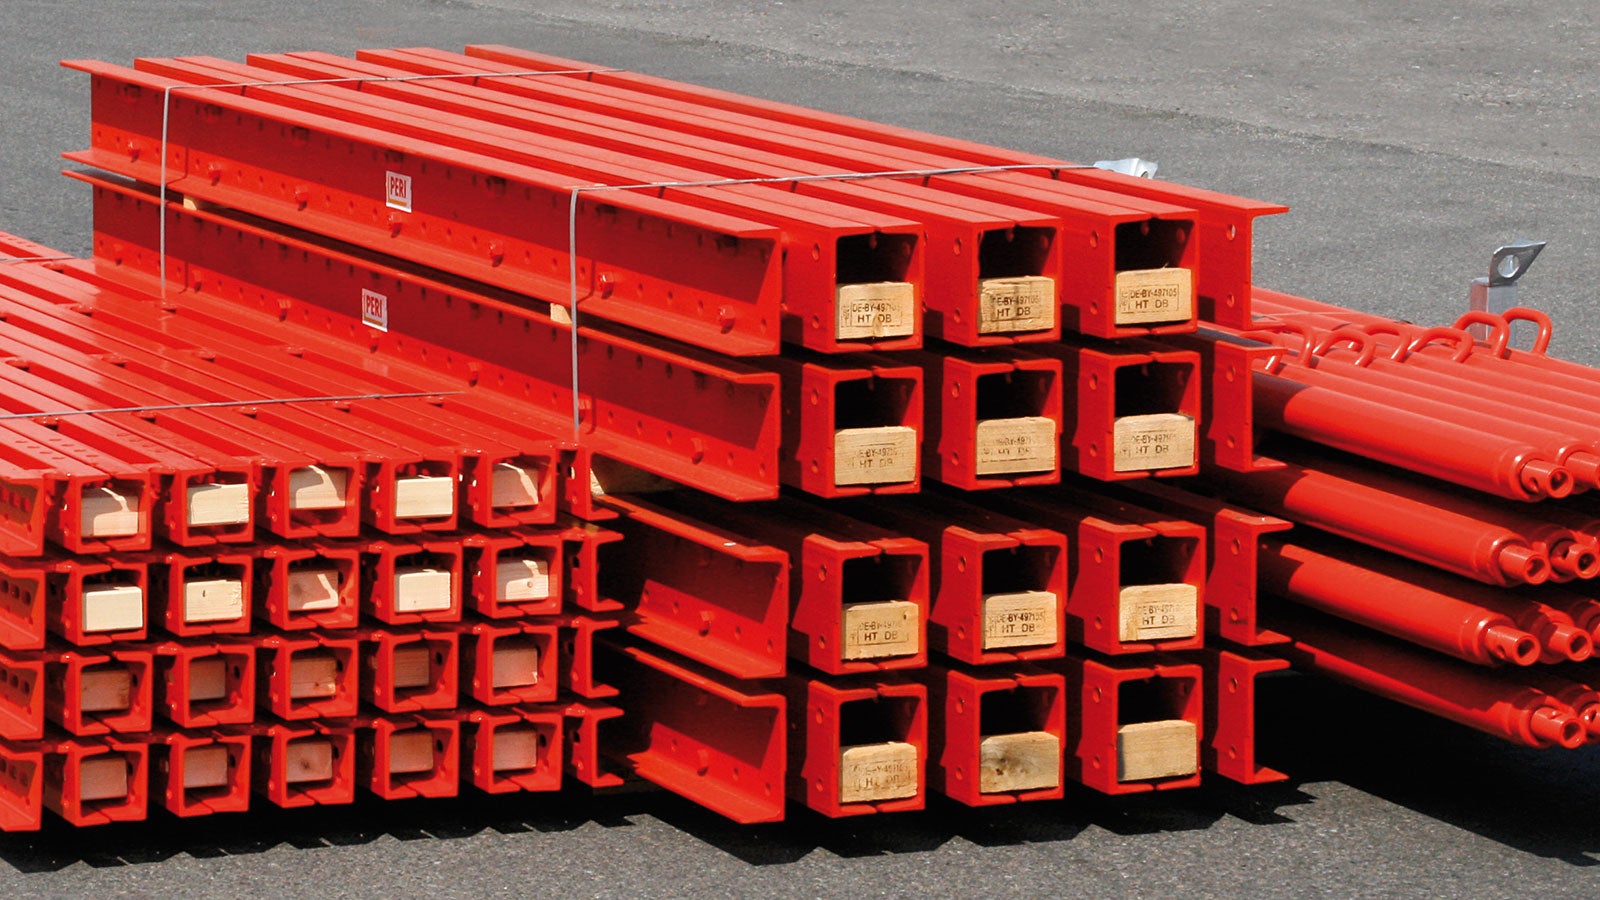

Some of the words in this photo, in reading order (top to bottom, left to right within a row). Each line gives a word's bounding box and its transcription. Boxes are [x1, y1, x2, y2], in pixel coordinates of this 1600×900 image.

[390, 177, 407, 198] PERI
[366, 294, 382, 318] PERI
[1135, 300, 1149, 309] HT
[1154, 299, 1169, 309] DB
[997, 308, 1010, 317] HT
[1016, 306, 1031, 316] DB
[857, 314, 871, 323] HT
[877, 313, 892, 323] DB
[1142, 616, 1155, 625] HT
[1002, 624, 1015, 633] HT
[1021, 623, 1035, 632] DB
[864, 632, 878, 641] HT
[884, 631, 898, 640] DB
